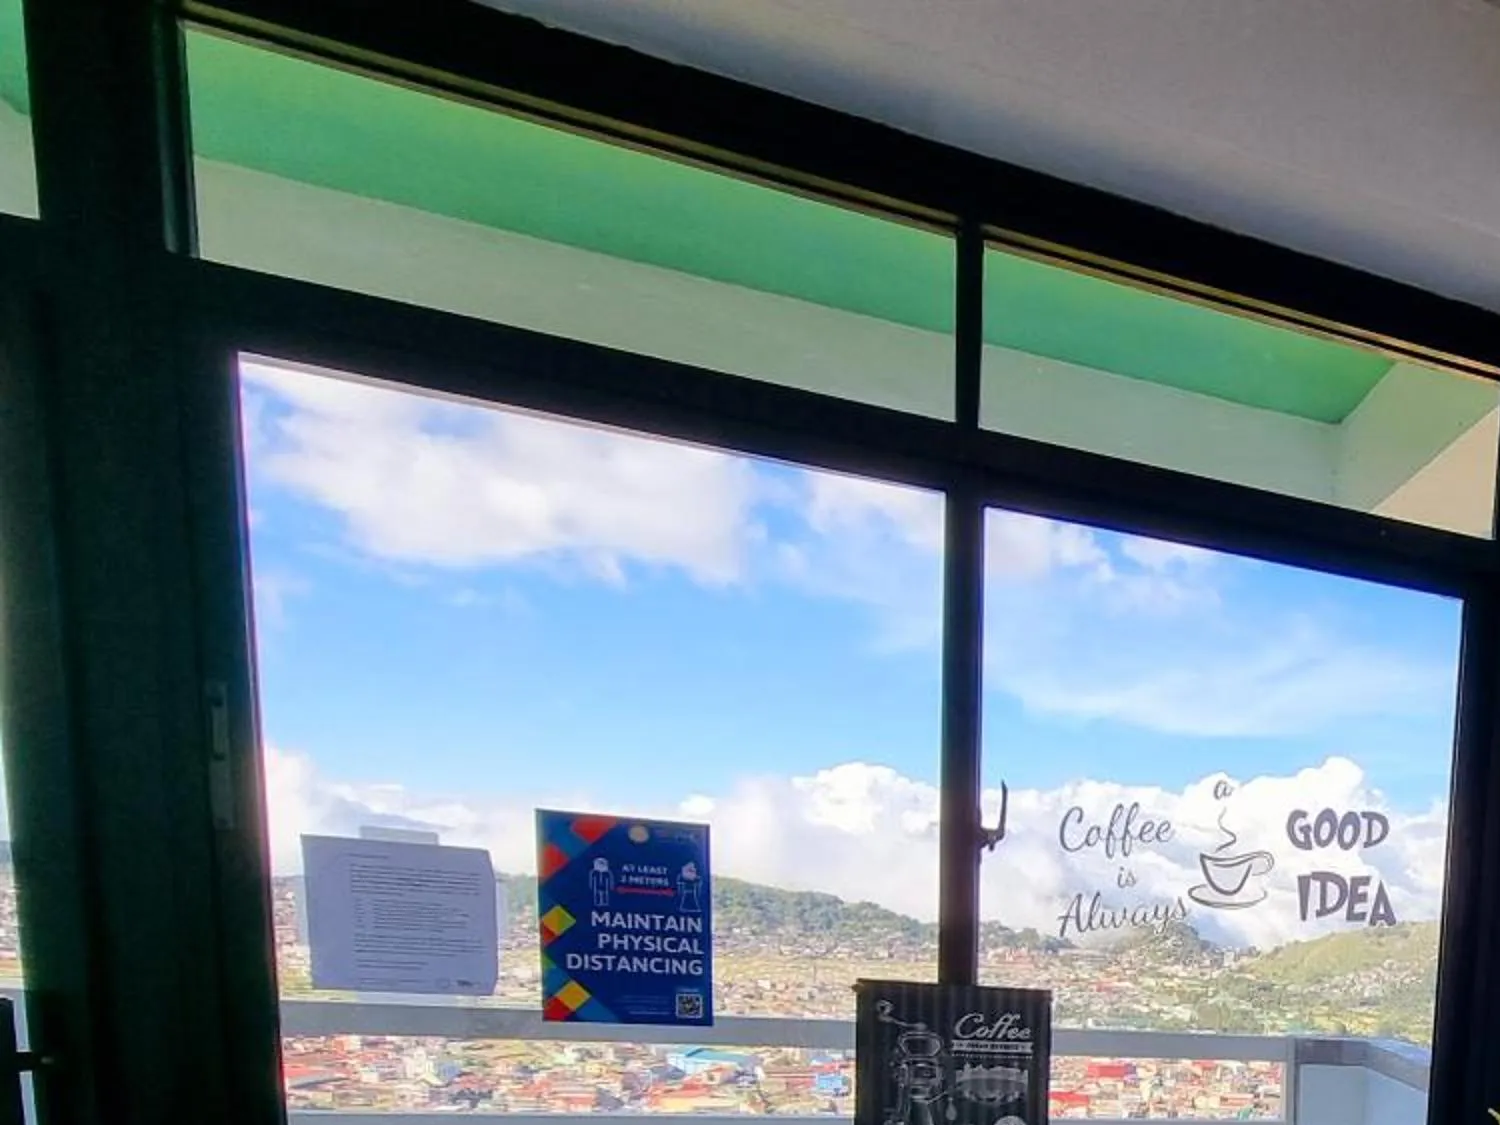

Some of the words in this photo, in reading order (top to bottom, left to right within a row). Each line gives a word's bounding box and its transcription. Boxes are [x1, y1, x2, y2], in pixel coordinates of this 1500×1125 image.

[1213, 780, 1234, 800] a
[1059, 802, 1175, 859] Coffee
[1286, 808, 1390, 850] GOOD
[1117, 866, 1137, 888] is
[1296, 871, 1396, 927] IDEA
[590, 911, 702, 934] MAINTAIN
[1057, 891, 1190, 938] Always
[598, 933, 704, 955] PHYSICAL
[566, 953, 704, 976] DISTANCING
[954, 1012, 1032, 1039] Coffee
